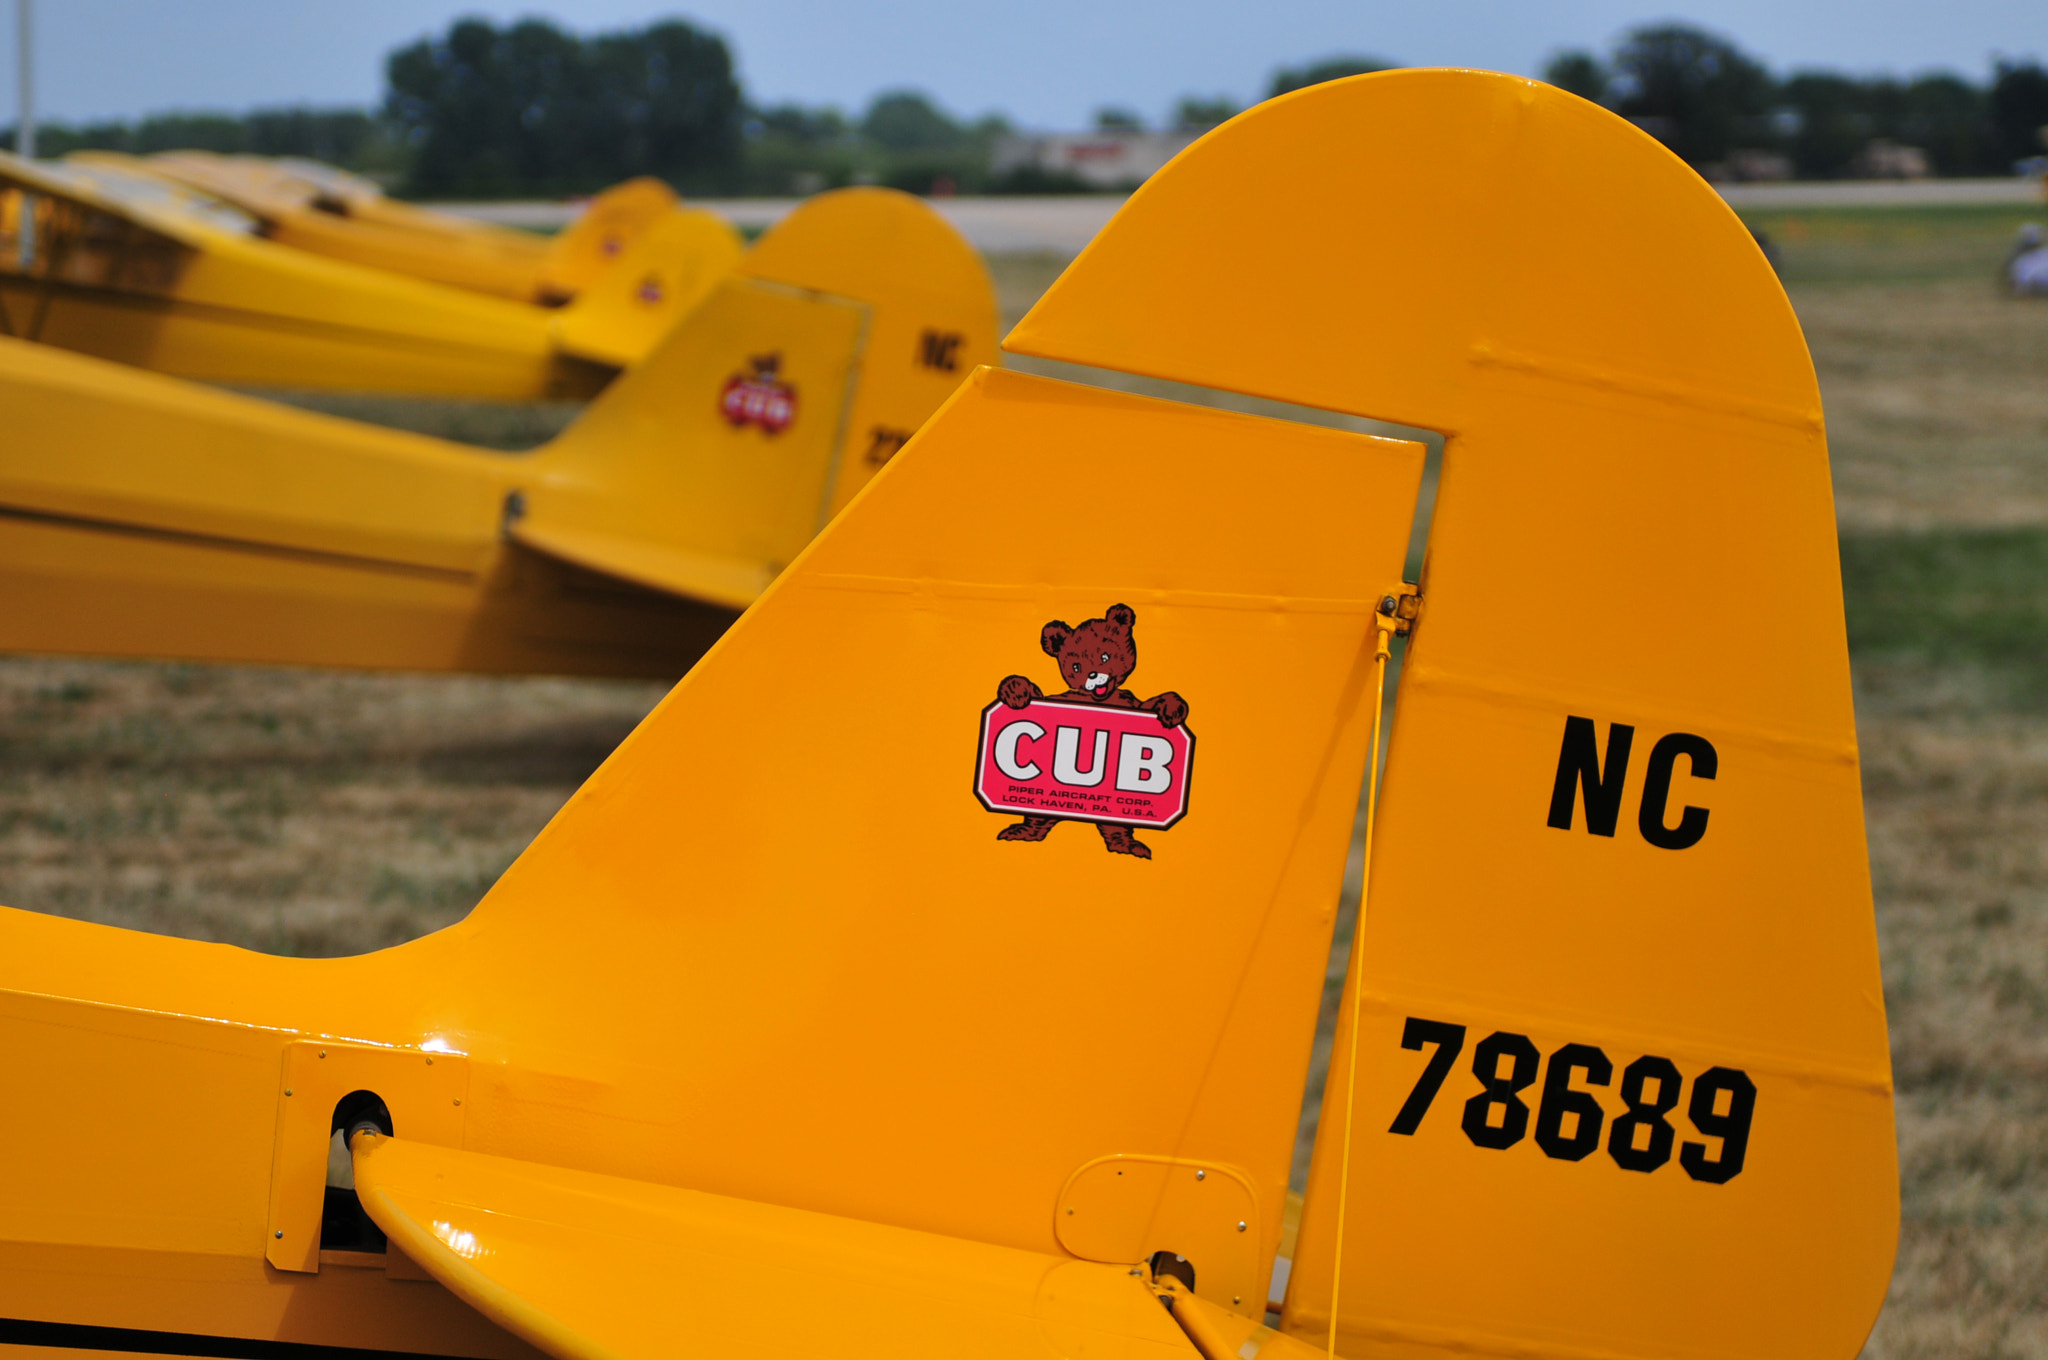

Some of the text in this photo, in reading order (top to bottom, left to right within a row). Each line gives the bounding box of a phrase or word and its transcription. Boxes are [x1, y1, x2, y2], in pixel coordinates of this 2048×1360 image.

[918, 328, 963, 373] NC
[725, 386, 792, 422] CUB
[994, 720, 1175, 795] CUB
[1008, 785, 1154, 807] PIPER AIRCRAFT CORP.
[1547, 715, 1718, 850] NC
[1002, 795, 1157, 818] LOCK HAVEN, PA. U.S.A.
[1388, 1016, 1757, 1184] 78689
